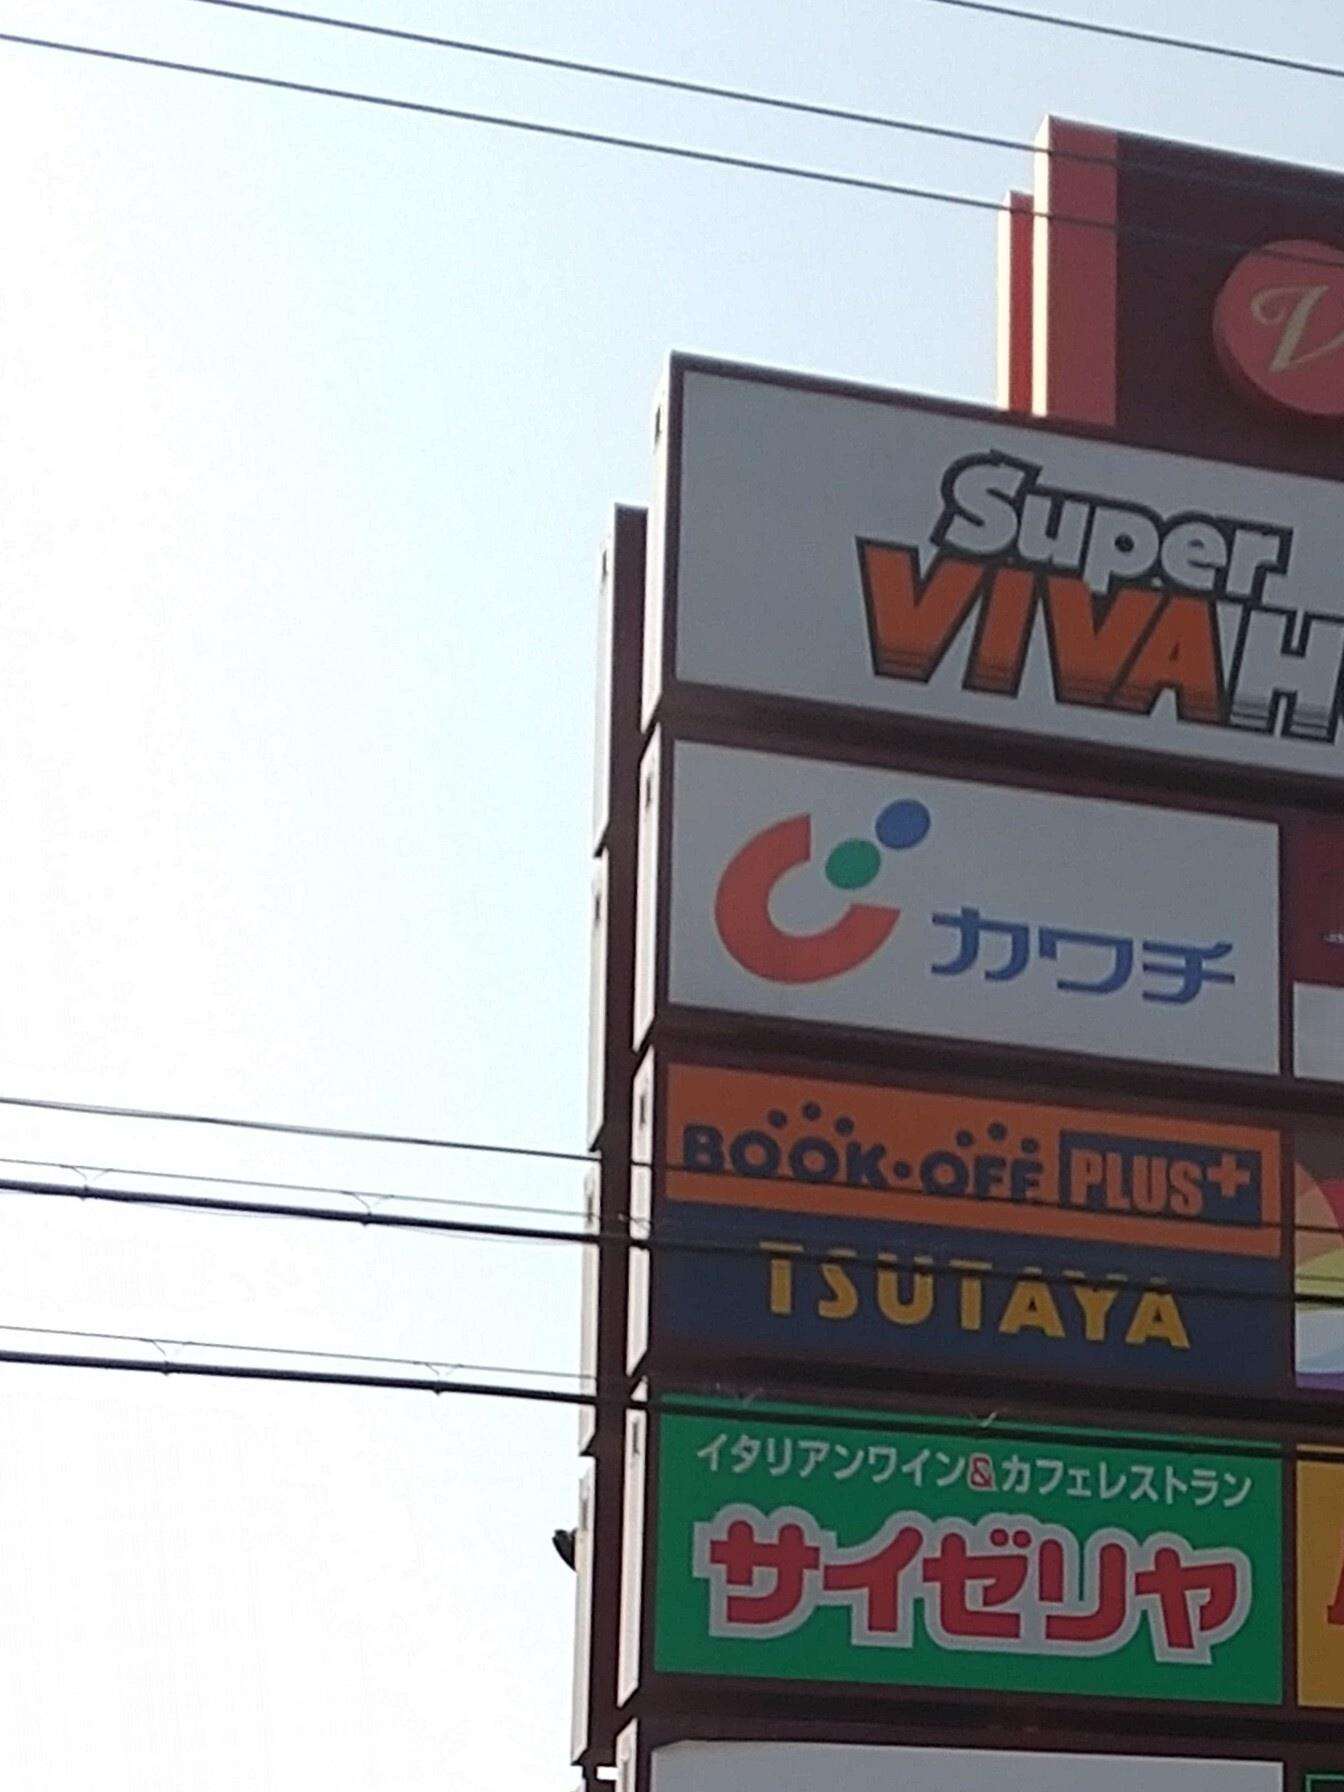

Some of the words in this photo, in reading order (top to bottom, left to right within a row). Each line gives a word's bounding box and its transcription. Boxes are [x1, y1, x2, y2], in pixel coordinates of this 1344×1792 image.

[930, 447, 1294, 602] Super
[931, 905, 1236, 1005] カワチ
[759, 1241, 1192, 1350] TSUTAYA
[700, 1510, 1246, 1658] サイゼリヤ
